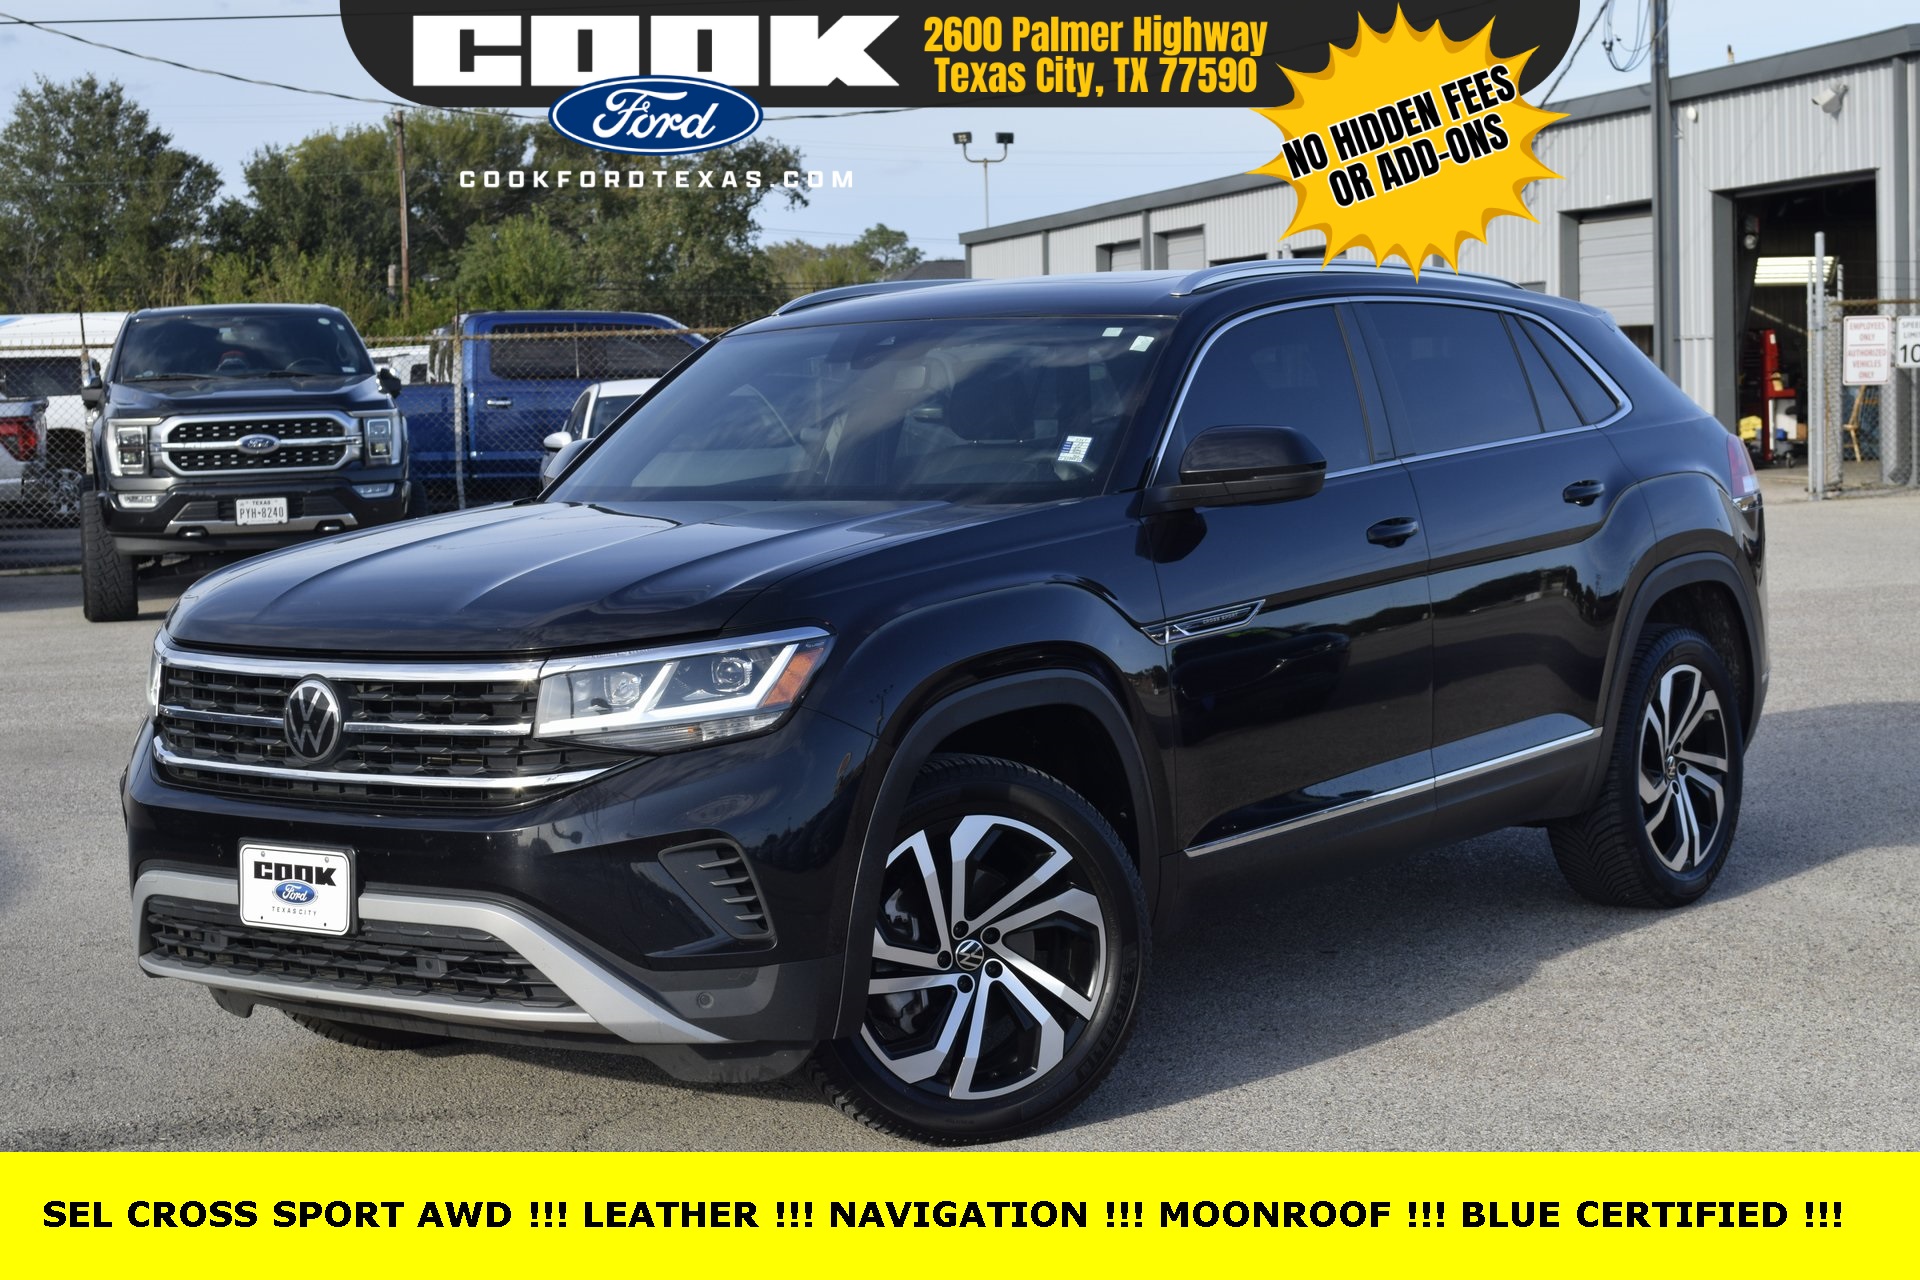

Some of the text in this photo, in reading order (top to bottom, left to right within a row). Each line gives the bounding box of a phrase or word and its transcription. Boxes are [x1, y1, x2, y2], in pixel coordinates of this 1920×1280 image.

[1849, 322, 1885, 330] EMPLOYEES
[1859, 333, 1875, 341] ONLY
[1848, 349, 1886, 357] AUTHORIZED
[1853, 360, 1881, 368] VEHICLES
[254, 861, 336, 887] COOK
[282, 884, 308, 902] Ford
